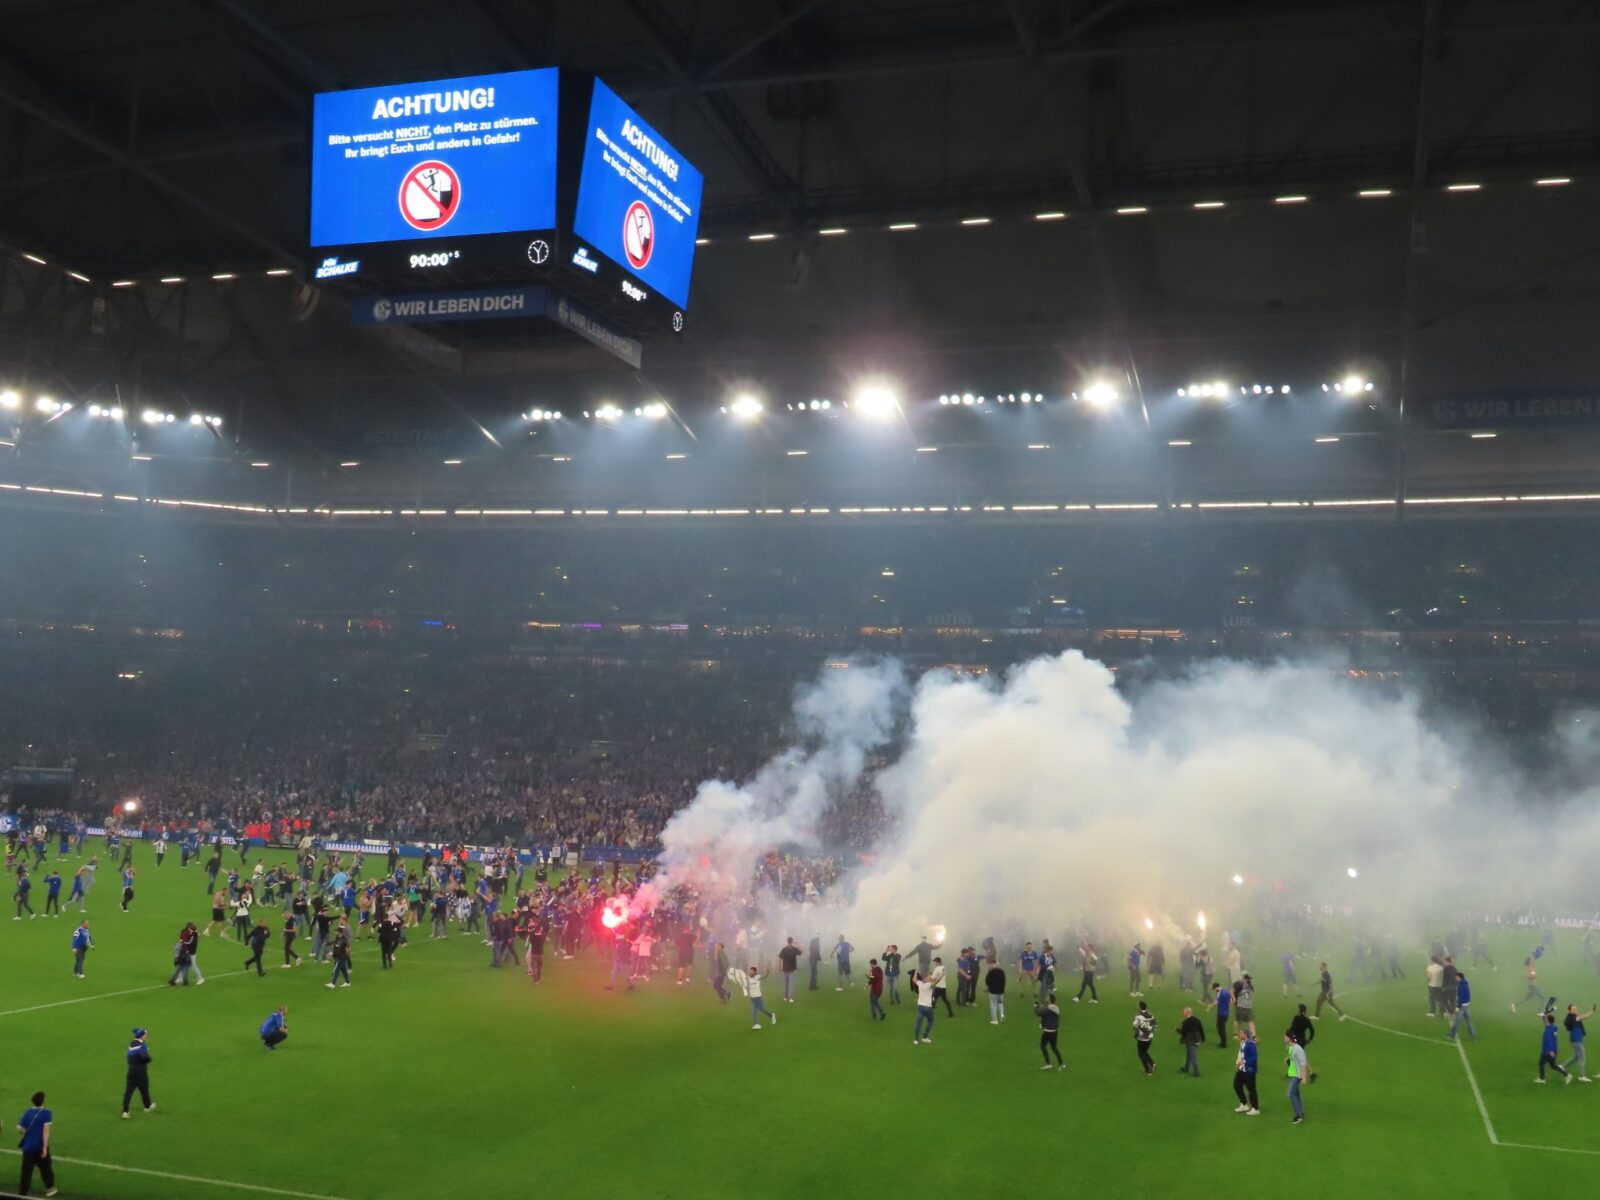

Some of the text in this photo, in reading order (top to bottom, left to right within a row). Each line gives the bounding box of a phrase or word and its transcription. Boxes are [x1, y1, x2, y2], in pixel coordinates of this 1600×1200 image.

[372, 88, 494, 119] ACHTUNG!
[329, 116, 538, 145] Bitte versucht NICHT, den Platz zu stürmen.
[345, 132, 520, 158] Ihr bringt Euch und andere in Gefahr!
[621, 119, 678, 182] ACHTUNG!
[316, 263, 358, 278] SCHALKE
[410, 253, 448, 268] 90:00
[395, 294, 524, 317] WIR LEBEN DICH
[570, 310, 586, 329] WIR
[586, 320, 612, 344] LEBEN
[1464, 400, 1511, 418] WIR
